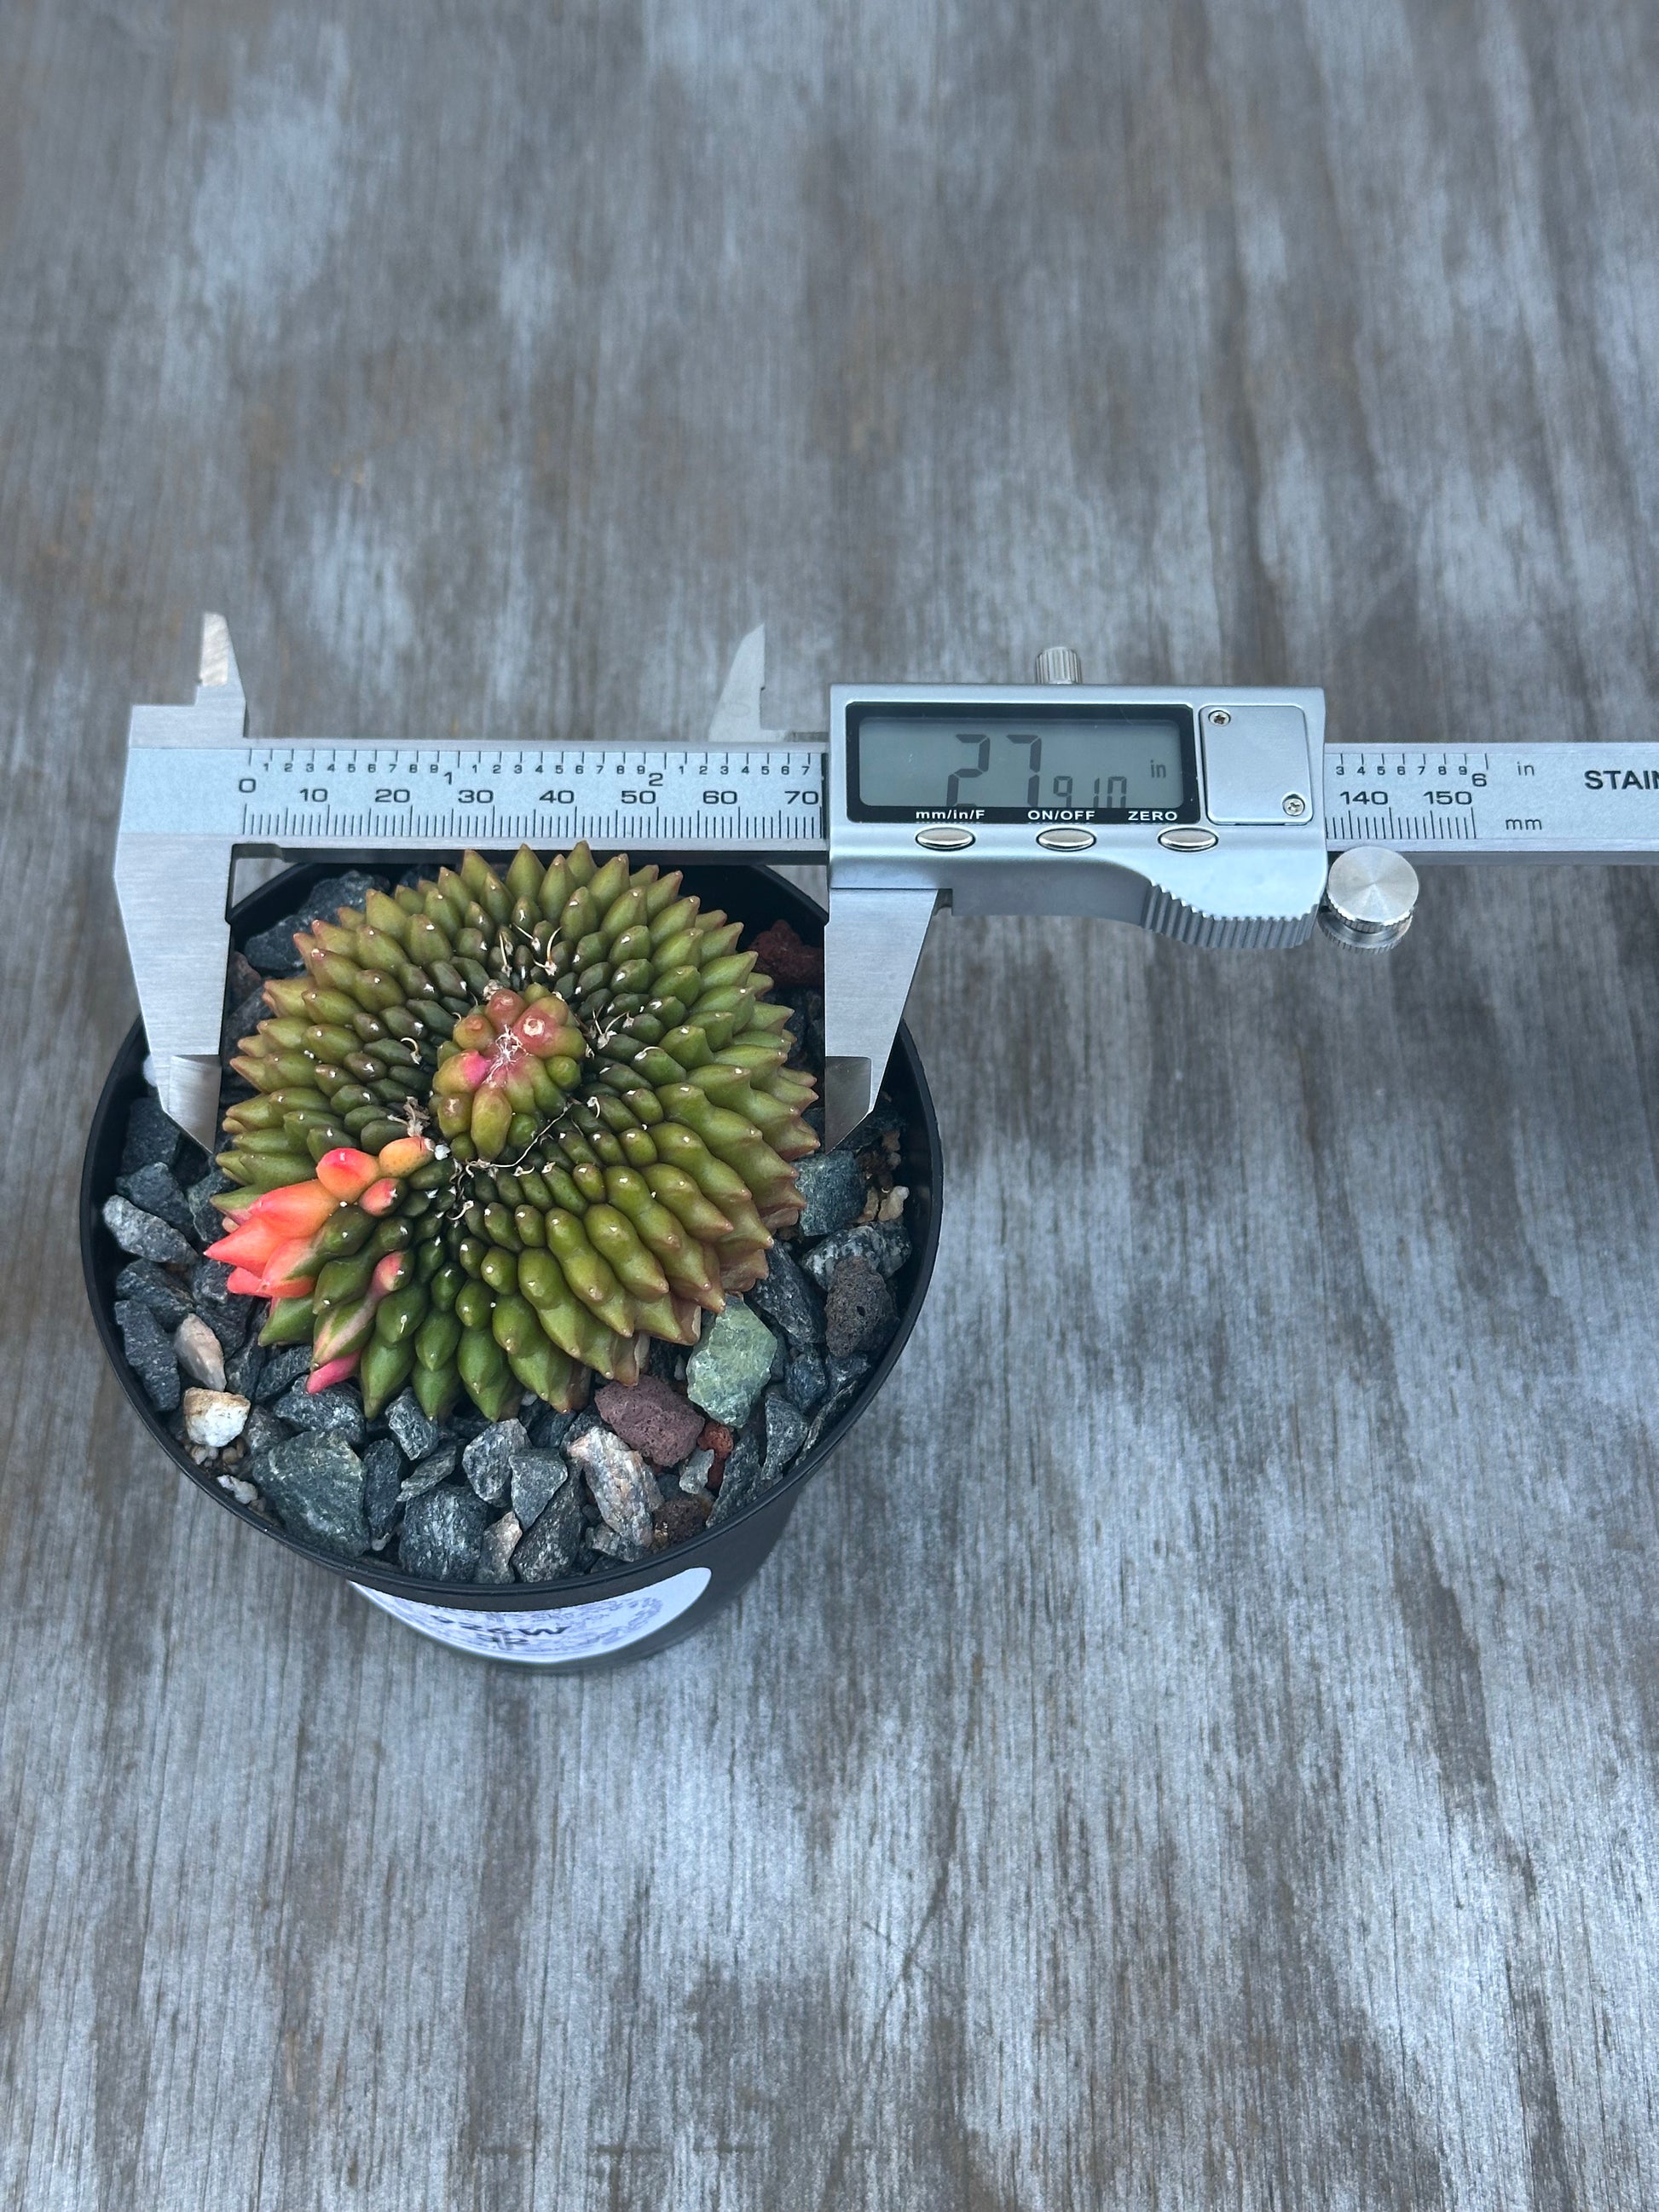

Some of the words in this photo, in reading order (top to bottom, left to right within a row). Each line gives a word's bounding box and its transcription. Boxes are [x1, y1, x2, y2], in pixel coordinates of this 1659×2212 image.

[263, 762, 269, 772] 1
[283, 762, 294, 773] 2
[305, 762, 315, 773] 3
[327, 763, 336, 773] 4
[347, 763, 356, 774] 5
[367, 763, 377, 774] 6
[388, 763, 397, 774] 7
[408, 763, 419, 774] 8
[429, 763, 439, 774] 9
[442, 771, 453, 786] 1
[471, 764, 478, 776] 1
[492, 764, 502, 776] 2
[513, 764, 523, 776] 3
[534, 764, 544, 776] 4
[554, 764, 564, 776] 5
[575, 764, 585, 776] 6
[595, 764, 604, 776] 7
[616, 764, 626, 776] 8
[636, 764, 646, 776] 9
[648, 772, 664, 787] 2
[678, 765, 685, 776] 1
[698, 765, 708, 776] 2
[720, 765, 730, 776] 3
[740, 765, 750, 776] 4
[760, 765, 770, 776] 5
[780, 765, 790, 776] 6
[801, 765, 811, 776] 7
[1150, 759, 1166, 778] in
[1335, 765, 1345, 777] 3
[1356, 765, 1367, 777] 4
[1376, 765, 1386, 777] 5
[1396, 765, 1406, 777] 6
[1417, 765, 1427, 777] 7
[1437, 765, 1448, 777] 8
[1458, 765, 1468, 777] 9
[1471, 772, 1488, 788] 6
[1517, 760, 1535, 777] in
[238, 777, 257, 794] 0
[298, 788, 329, 803] 10
[374, 788, 411, 804] 20
[457, 788, 494, 804] 30
[539, 789, 575, 805] 40
[620, 789, 656, 805] 50
[702, 789, 738, 806] 60
[783, 790, 819, 806] 70
[1339, 790, 1389, 806] 140
[1423, 790, 1473, 806] 150
[916, 809, 986, 821] mm/in/F
[1027, 809, 1096, 822] ON/OFF
[1127, 810, 1178, 822] ZERO
[1505, 817, 1543, 831] mm
